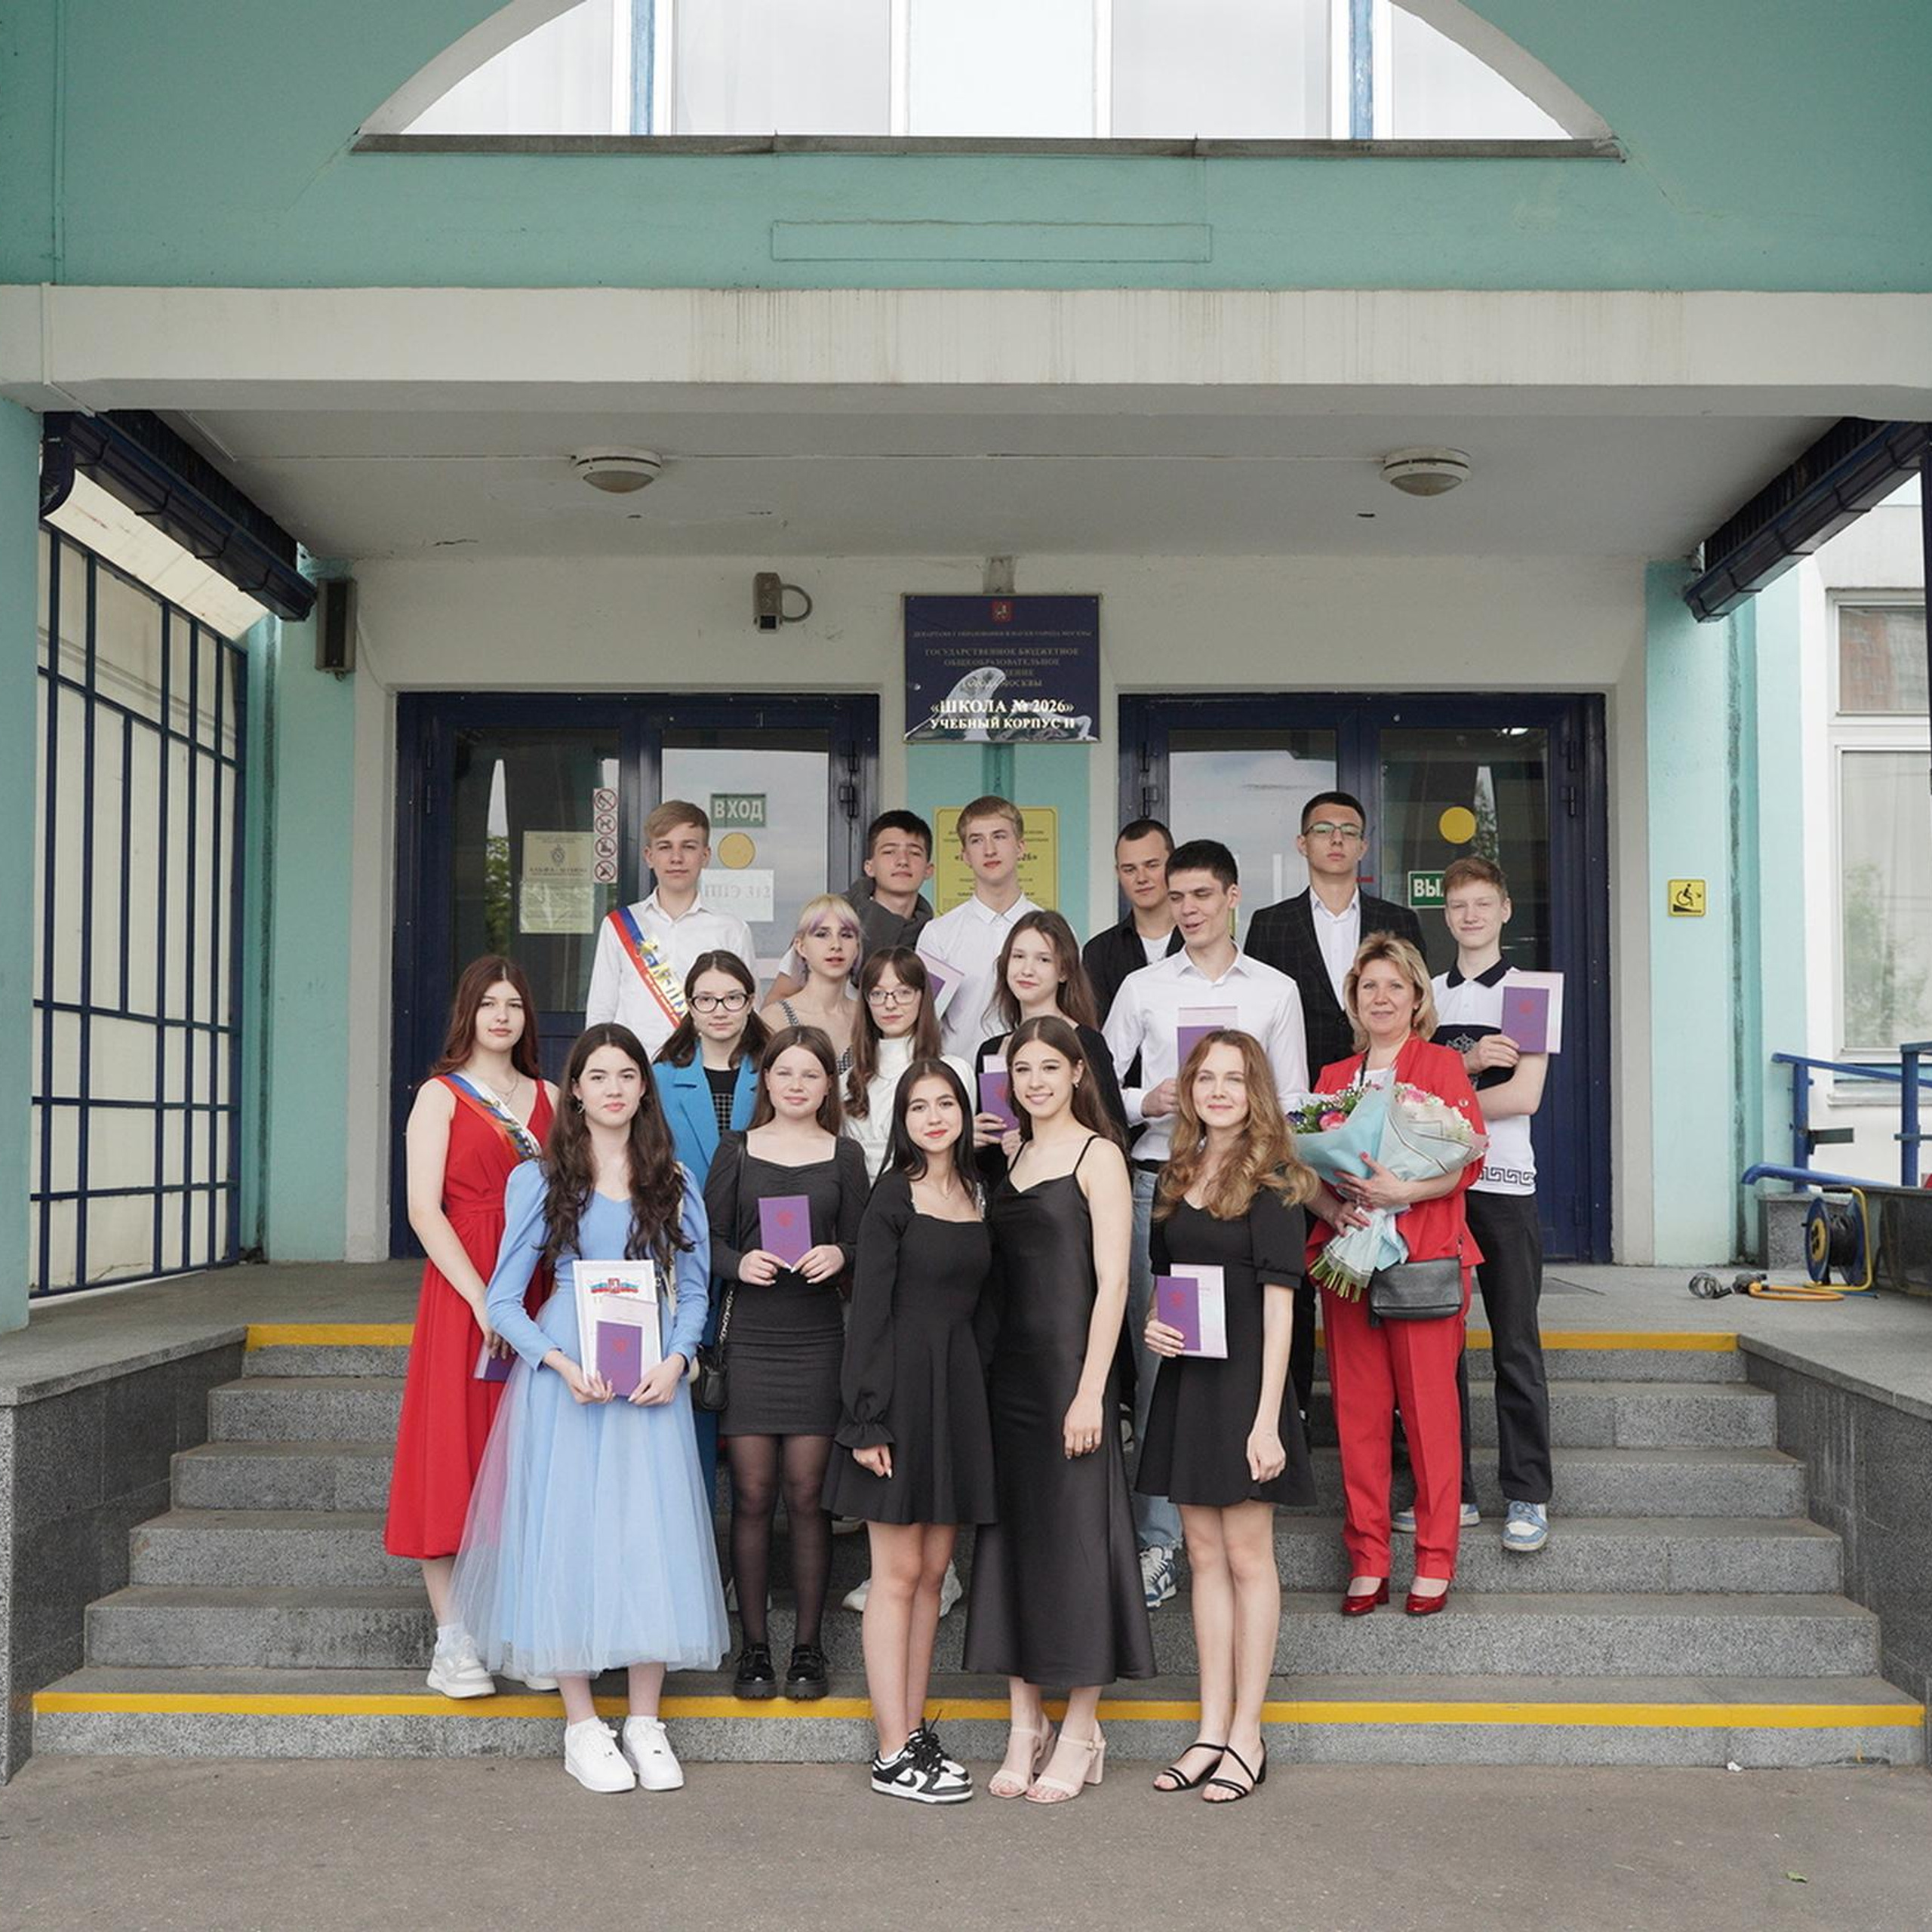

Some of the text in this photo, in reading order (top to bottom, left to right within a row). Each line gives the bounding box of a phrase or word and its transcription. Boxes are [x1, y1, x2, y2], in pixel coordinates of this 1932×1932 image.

[930, 700, 1075, 712] «ШКОЛА № 2026»
[931, 717, 1000, 729] УЧЕБНЫЙ
[1004, 718, 1060, 729] КОРПУС
[714, 800, 763, 822] ВХОД
[1414, 878, 1444, 897] ВЫ
